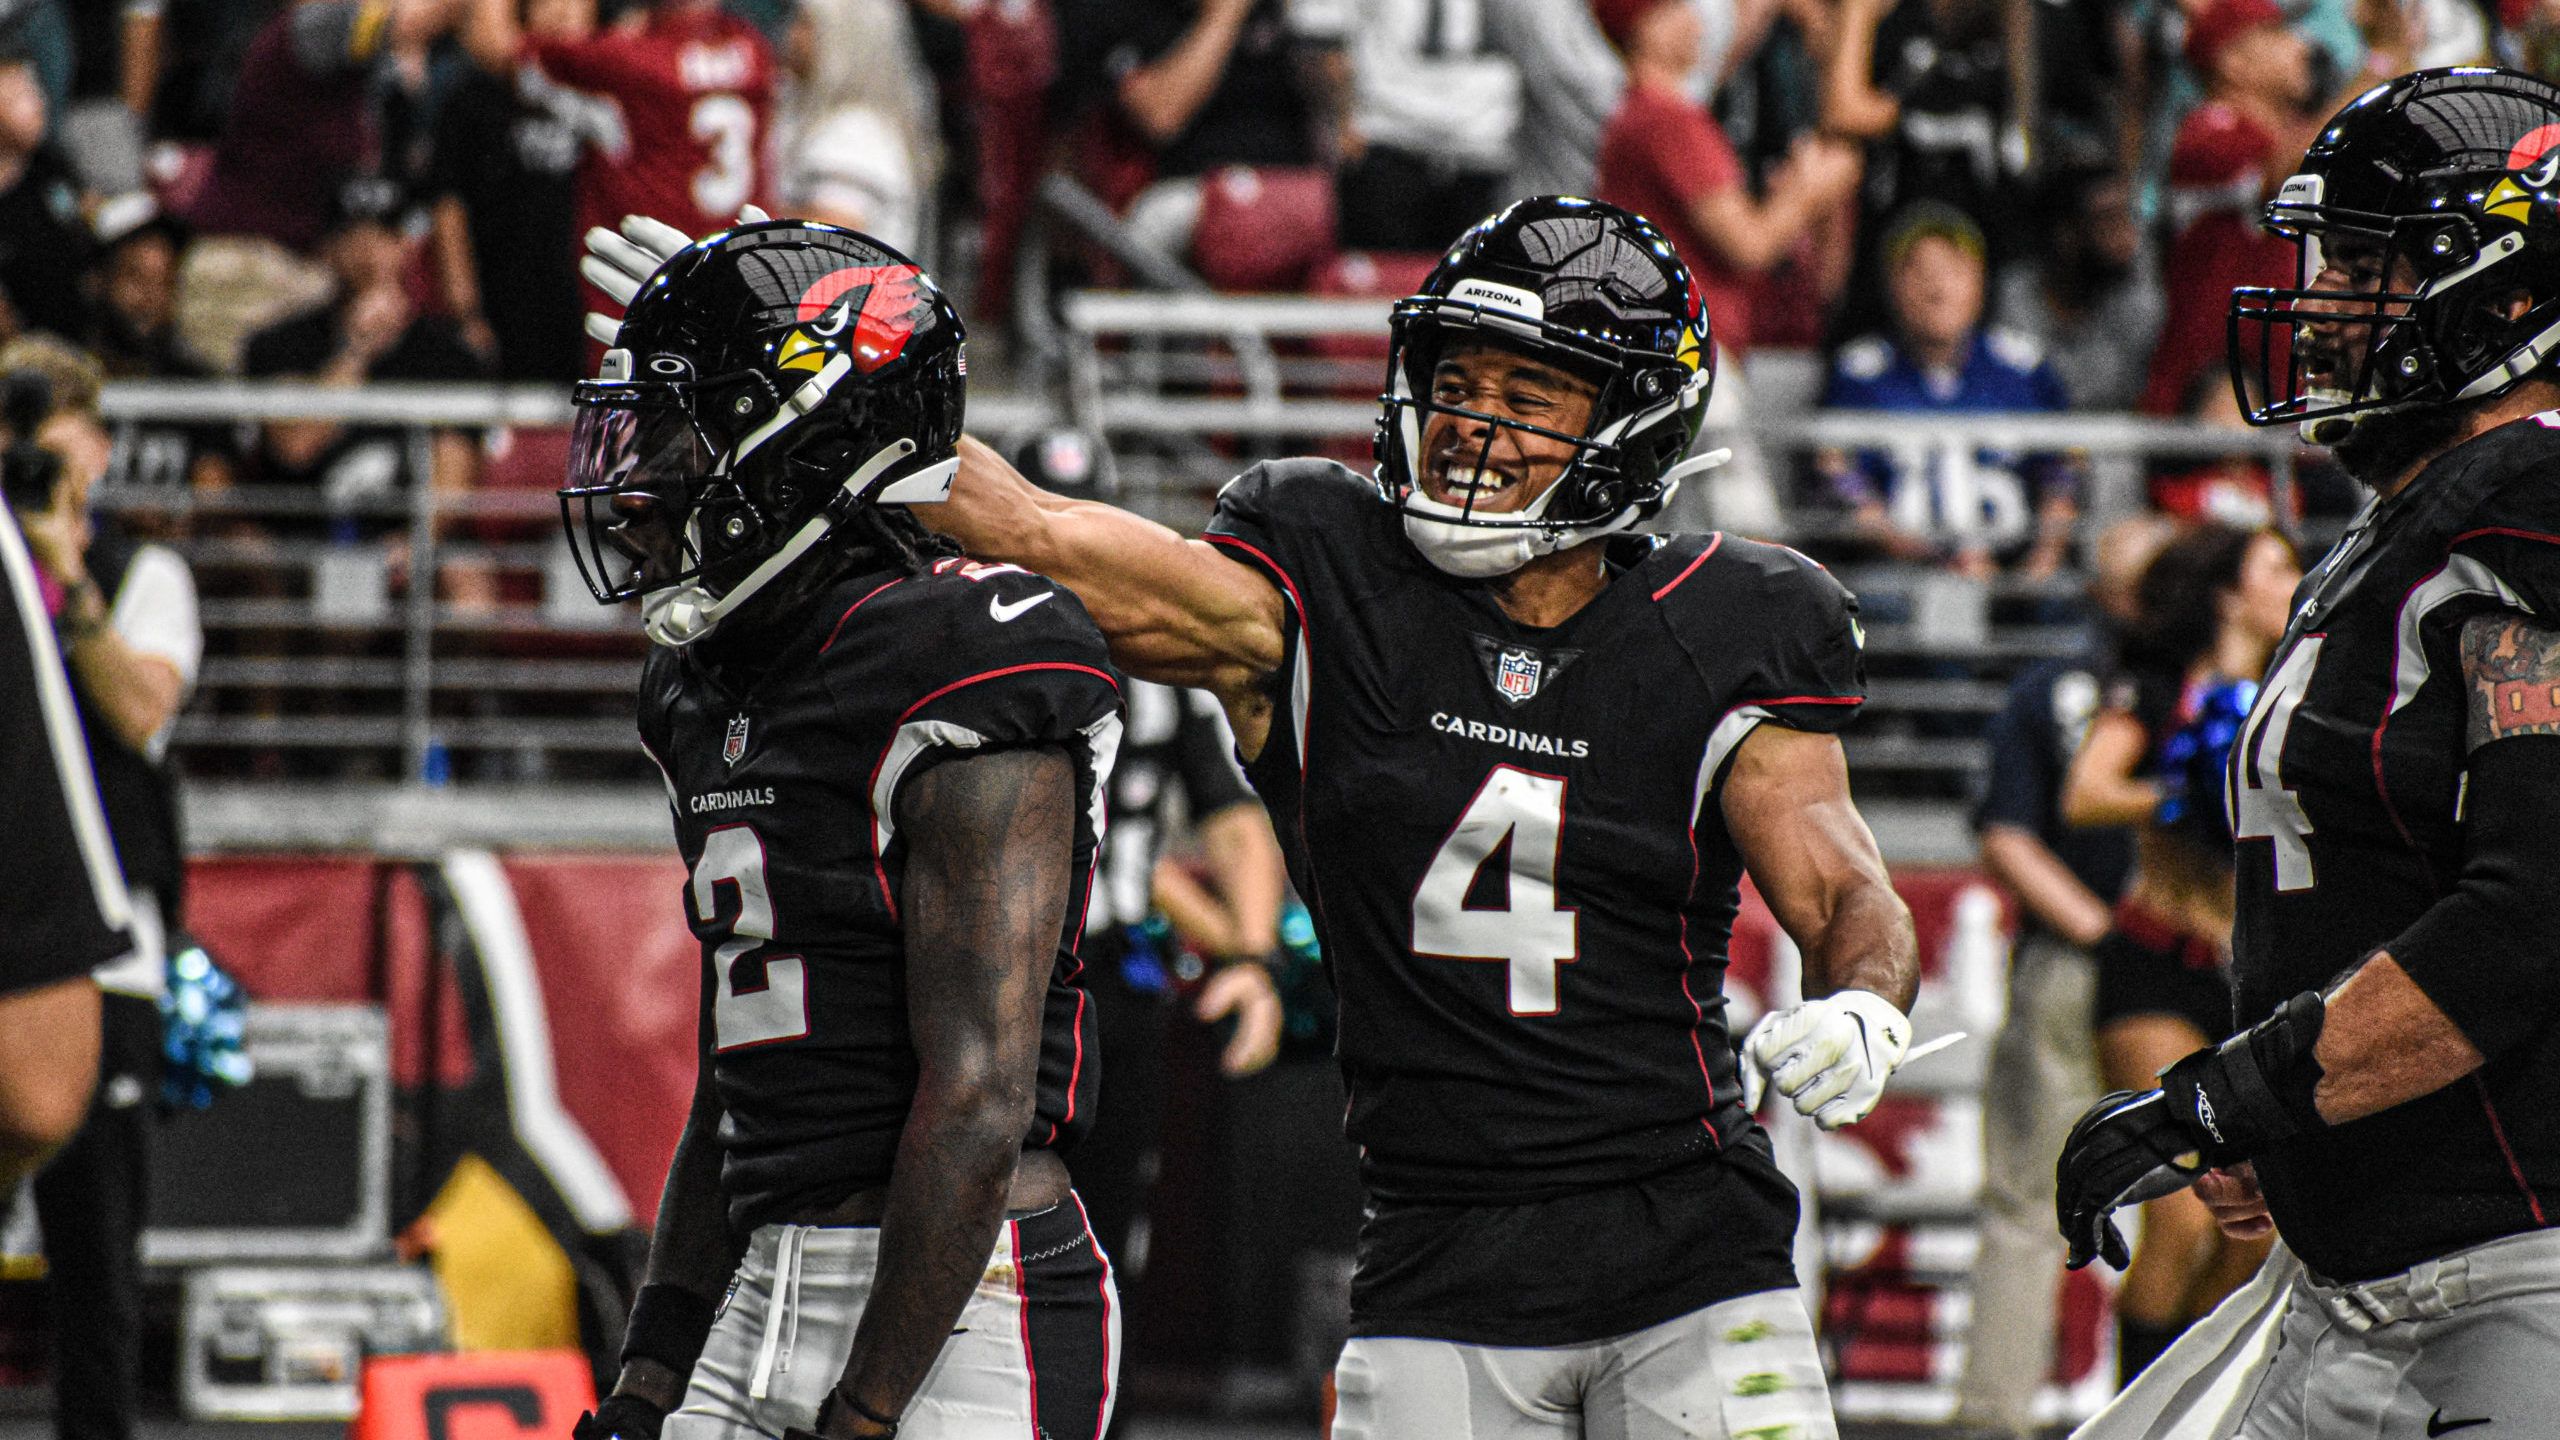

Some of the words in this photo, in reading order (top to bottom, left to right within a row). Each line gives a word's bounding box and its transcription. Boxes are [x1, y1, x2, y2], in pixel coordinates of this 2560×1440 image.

[690, 95, 756, 216] 3
[1464, 287, 1522, 307] ARIZONA
[1504, 671, 1530, 693] NFL
[1430, 712, 1589, 758] CARDINALS
[690, 787, 776, 814] CARDINALS
[1411, 762, 1580, 1017] 4
[693, 821, 811, 1053] 2
